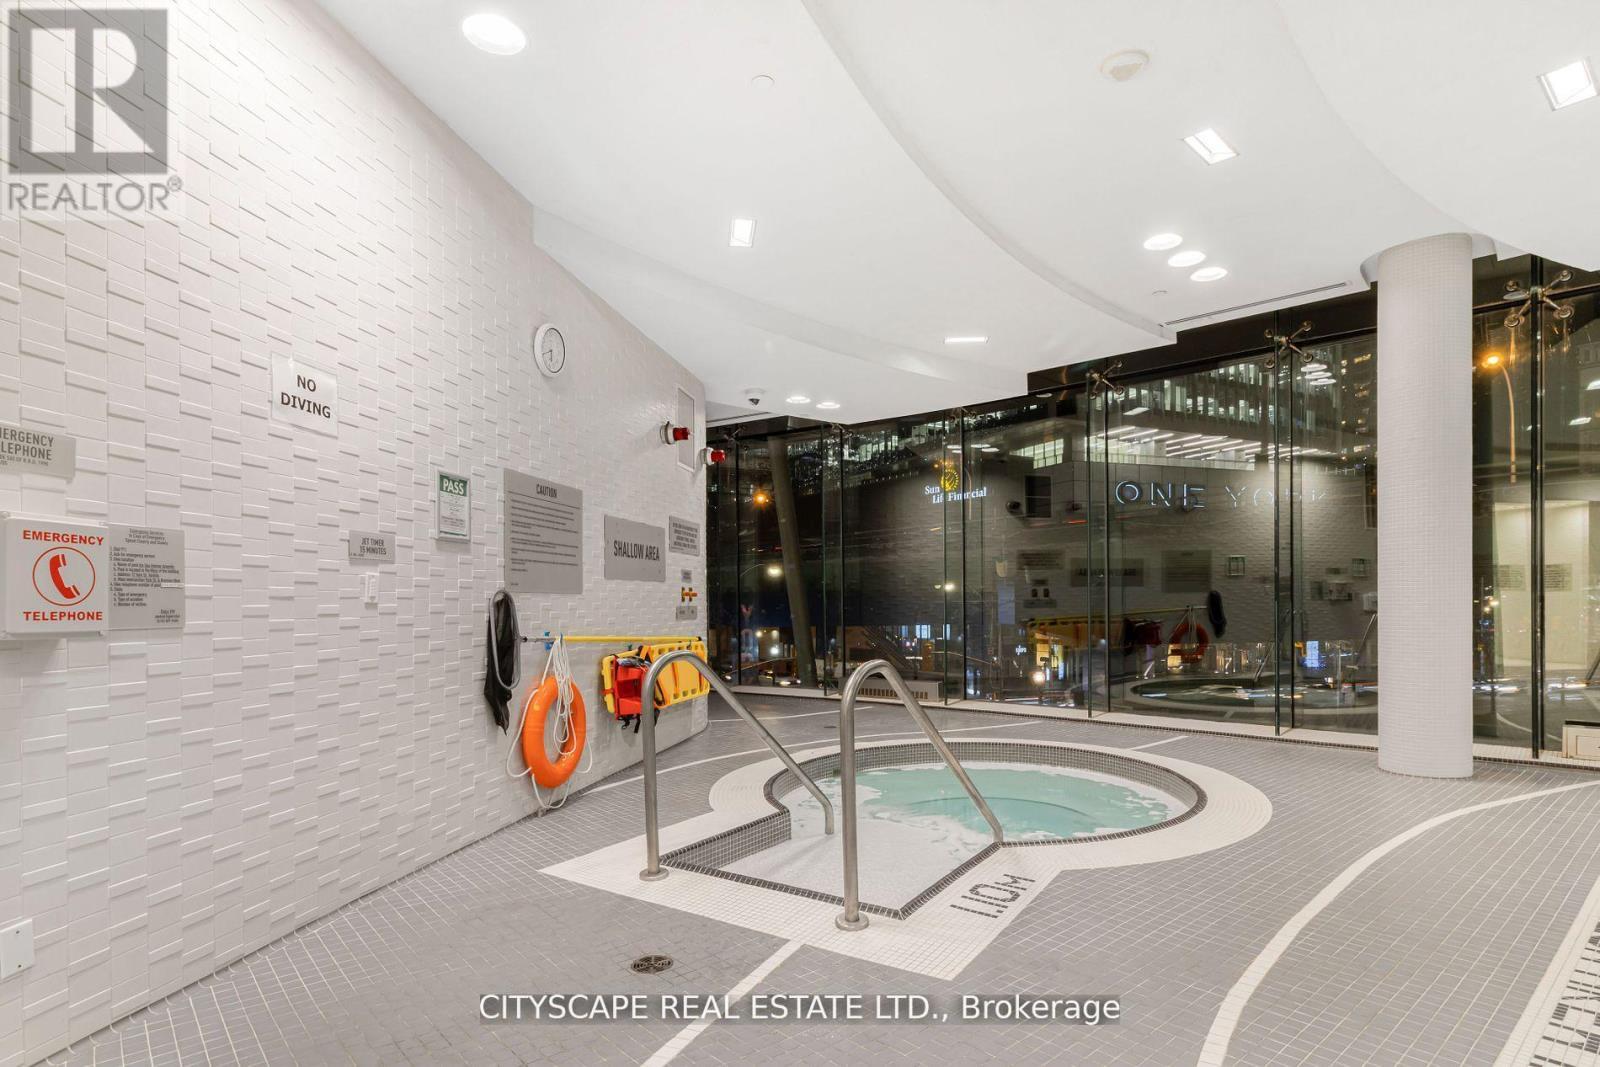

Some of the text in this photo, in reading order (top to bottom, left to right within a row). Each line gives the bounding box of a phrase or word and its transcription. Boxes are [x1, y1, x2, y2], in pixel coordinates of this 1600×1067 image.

[297, 374, 316, 392] NO
[281, 391, 331, 419] DIVING
[0, 440, 52, 461] LEPHONE
[443, 479, 464, 495] PASS
[536, 484, 557, 498] CAUTION
[925, 485, 940, 495] Sun
[1115, 481, 1205, 508] ONE
[932, 493, 945, 504] Lif
[23, 530, 104, 546] EMERGENCY
[361, 537, 384, 547] JET TIMER
[366, 546, 387, 555] MINUTES
[613, 540, 660, 561] SHALLOW AREA
[23, 611, 103, 621] TELEPHONE
